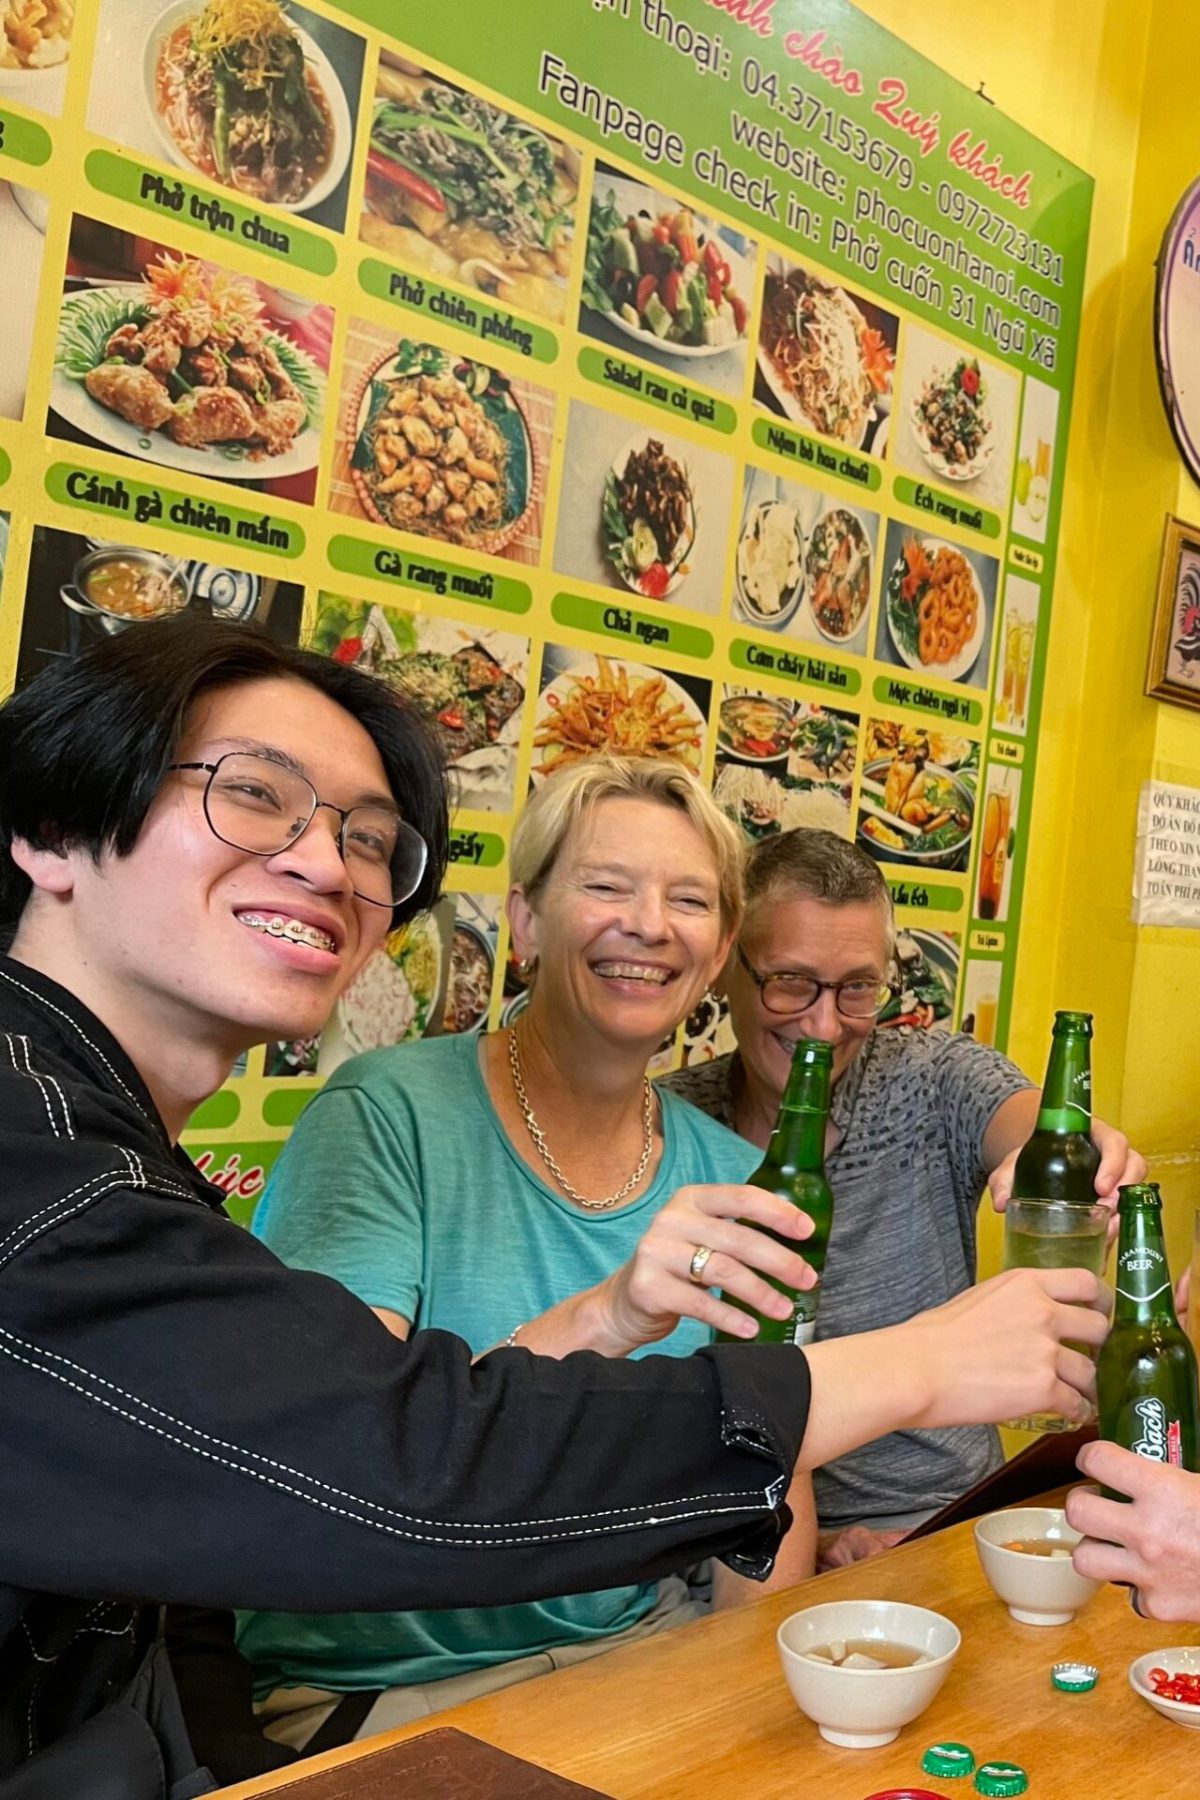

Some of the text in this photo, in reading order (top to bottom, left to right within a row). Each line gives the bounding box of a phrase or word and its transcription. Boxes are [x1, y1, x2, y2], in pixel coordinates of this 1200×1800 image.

[784, 31, 862, 94] chào
[874, 79, 940, 157] Quý
[949, 130, 1032, 208] khách
[643, 0, 731, 78] thoại:
[742, 59, 914, 189] 04.37153679
[936, 182, 1066, 287] 0972723131
[140, 173, 291, 254] Phở trộn chua
[539, 52, 1057, 370] Fanpage check in: Phở cuốn 31 Ngũ Xã
[732, 111, 1061, 329] website: phocuonhanoi.com
[389, 273, 425, 306] Phở
[429, 291, 478, 328] chiên
[603, 359, 643, 391] Salad
[645, 381, 668, 402] rau
[799, 438, 814, 461] bò
[817, 446, 836, 471] hoa
[66, 472, 290, 549] Cánh gà chiên mắm
[936, 501, 958, 524] rang
[374, 550, 402, 577] Gà
[407, 563, 448, 594] rang
[603, 607, 670, 645] Chả ngan
[777, 653, 806, 681] cháy
[913, 687, 940, 709] chiên
[1150, 836, 1178, 852] THEO
[1180, 842, 1195, 856] XIN
[1118, 1246, 1163, 1267] PARAMOUNT
[1126, 1259, 1154, 1272] BEER
